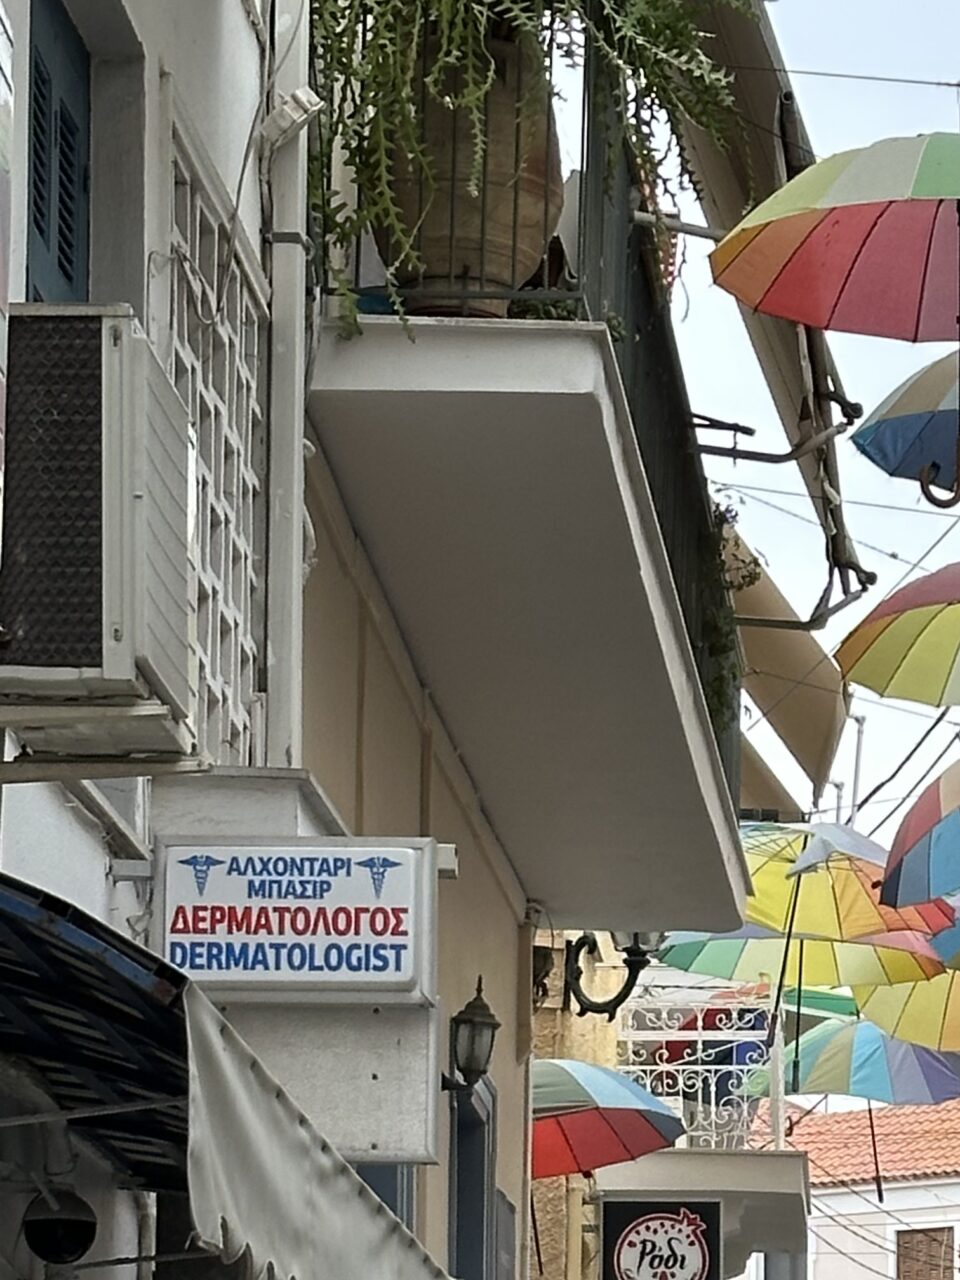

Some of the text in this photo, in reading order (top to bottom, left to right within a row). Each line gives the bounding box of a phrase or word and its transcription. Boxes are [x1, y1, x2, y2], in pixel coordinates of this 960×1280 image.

[226, 855, 352, 878] ΑΛΧΟΝΤΑΡΙ
[246, 878, 332, 900] ΜΠΑΣΙΡ
[169, 904, 409, 937] ΔΕΡΜΑΤΟΛΟΓΟΣ
[169, 941, 408, 973] DERMATOLOGIST
[636, 1236, 686, 1277] Ρόδι
